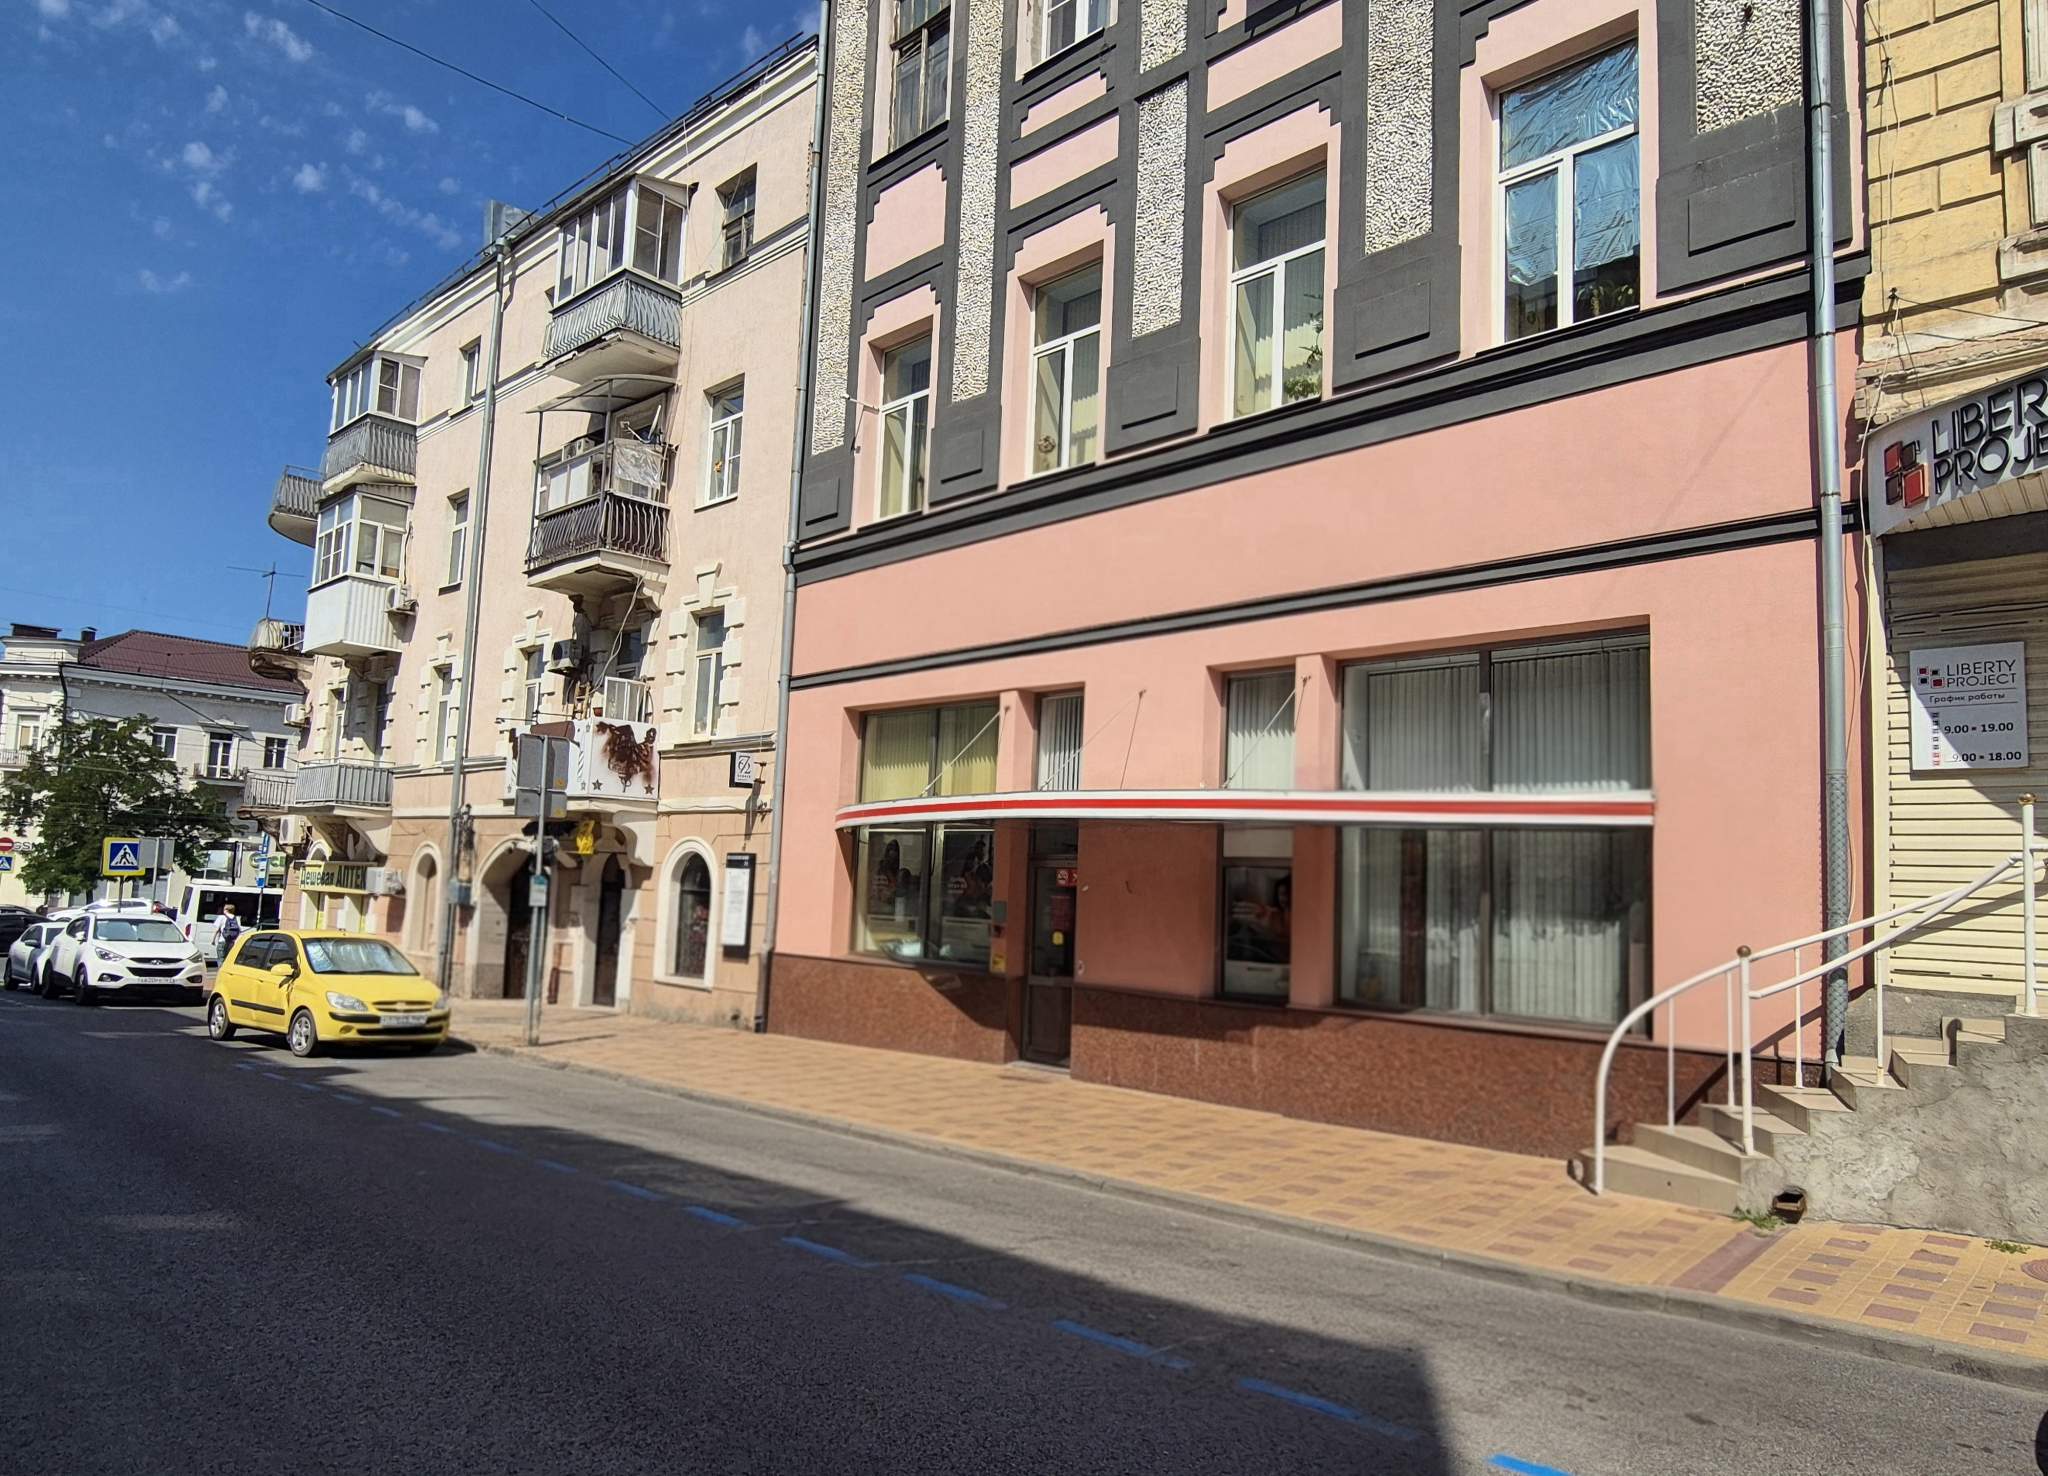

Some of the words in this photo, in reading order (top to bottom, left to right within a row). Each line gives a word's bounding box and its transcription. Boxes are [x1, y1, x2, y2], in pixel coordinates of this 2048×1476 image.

[1946, 659, 2017, 677] LIBERTY
[1946, 673, 2017, 688] PROJECT
[1929, 694, 1966, 704] График
[1968, 692, 2006, 703] работы
[1944, 724, 1969, 735] 9.00
[1981, 722, 2014, 733] 19.00
[1952, 752, 1977, 763] 9.00
[1988, 751, 2022, 762] 18.00
